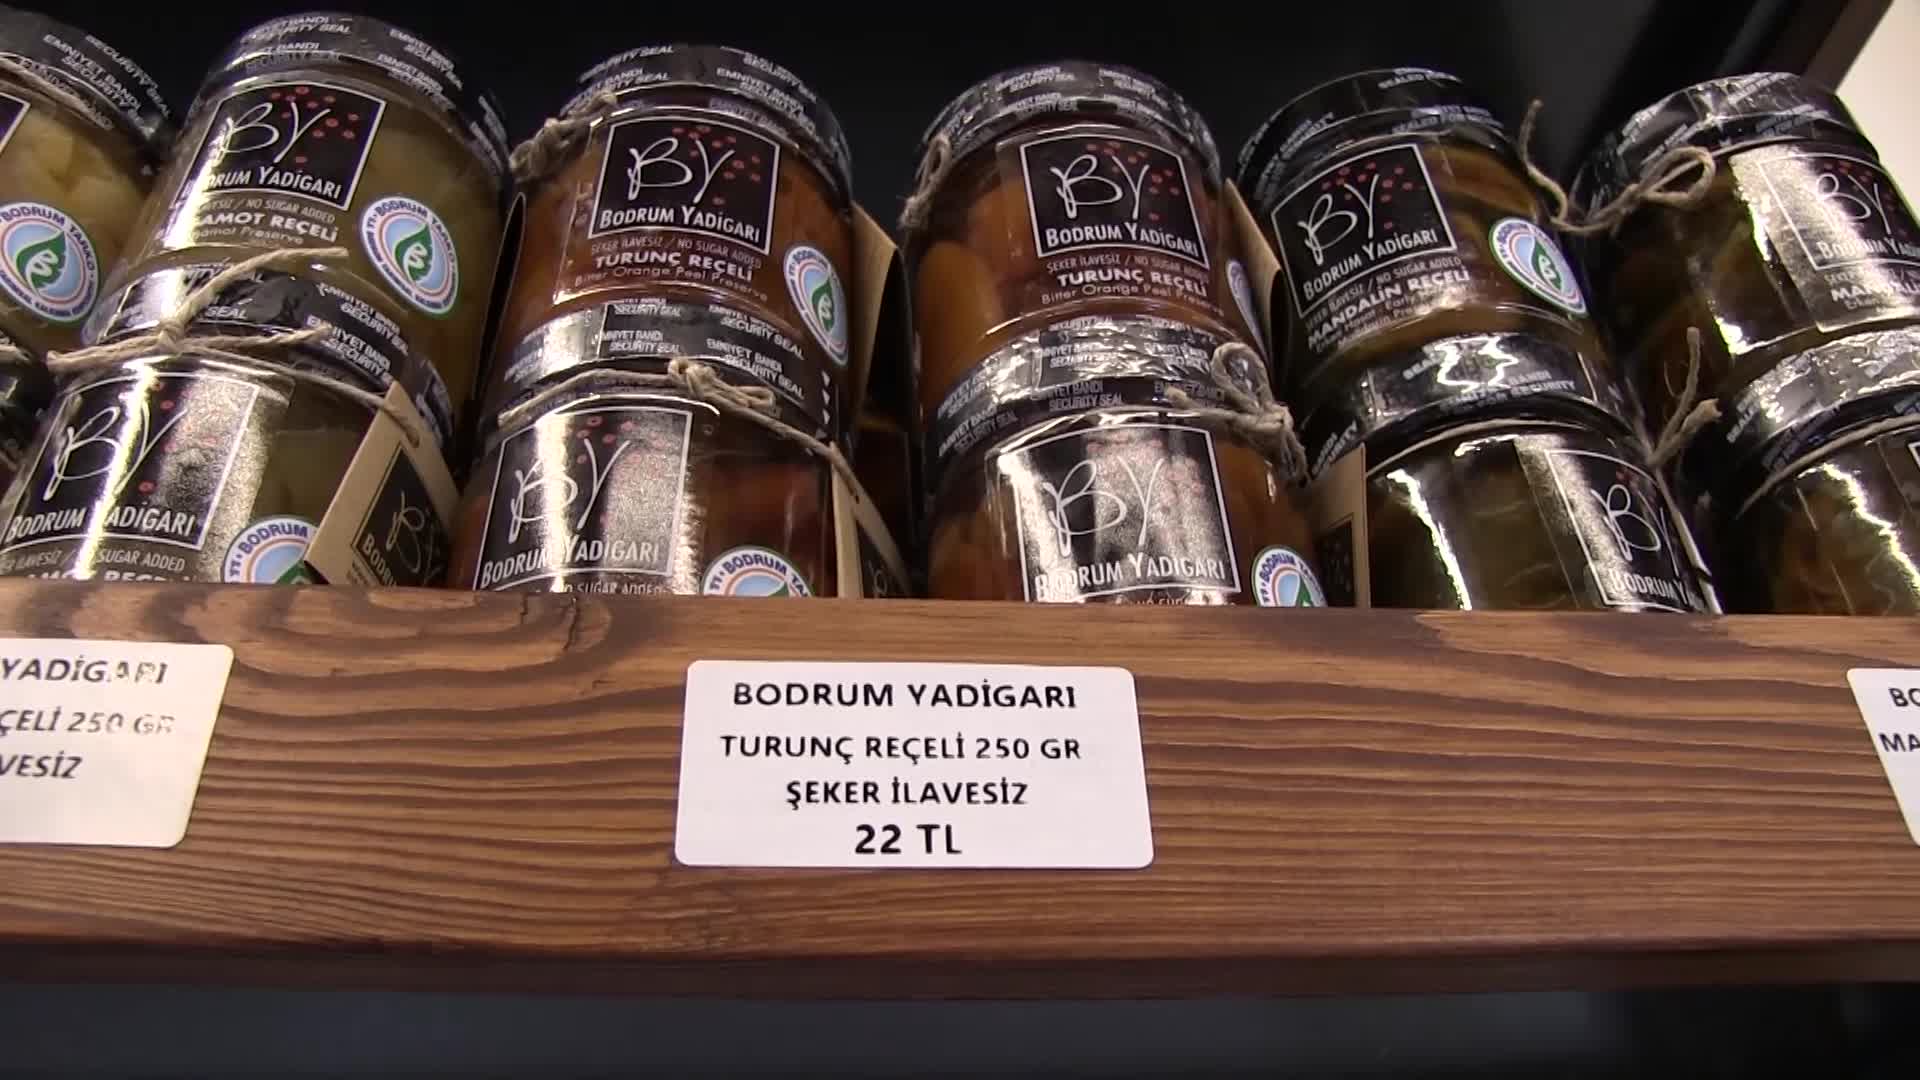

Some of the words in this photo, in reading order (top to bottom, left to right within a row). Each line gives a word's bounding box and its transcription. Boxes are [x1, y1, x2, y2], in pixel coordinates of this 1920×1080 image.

[259, 165, 342, 199] YADİGARI
[0, 206, 67, 227] BODRUM
[263, 200, 300, 213] SUGAR
[373, 200, 429, 218] BODRUM
[270, 213, 339, 244] REÇELİ
[600, 206, 676, 230] BODRUM
[680, 204, 762, 244] YADİGARI
[1045, 224, 1123, 249] BODRUM
[1123, 222, 1201, 258] YADİGARI
[594, 251, 682, 269] TURUNÇ
[688, 251, 753, 283] REÇELİ
[613, 265, 671, 280] Orange
[675, 266, 708, 280] Peel
[1302, 253, 1364, 301] BODRUM
[1361, 228, 1439, 262] YADİGARI
[1056, 269, 1145, 288] TURUNÇ
[1149, 270, 1209, 298] REÇELİ
[1080, 282, 1139, 297] Orange
[205, 305, 249, 319] SEAL
[1307, 283, 1404, 350] MANDALİN
[1510, 380, 1578, 398] SECURITY
[4, 506, 88, 545] BODRUM
[102, 501, 197, 538] ADİGARI
[238, 523, 309, 554] BODRUM
[97, 549, 140, 564] SUGAR
[140, 552, 187, 572] ADDED
[722, 553, 788, 576] BODRUM
[733, 681, 894, 708] BODRUM
[907, 677, 1077, 709] YADİGARI
[66, 711, 124, 735] 250
[720, 734, 855, 766] TURUNÇ
[865, 731, 966, 766] REÇELİ
[974, 737, 1031, 760] 250
[1039, 738, 1082, 760] GR
[785, 780, 881, 811] ŞEKER
[891, 775, 1029, 805] İLAVESİZ
[854, 823, 903, 855] 22
[916, 823, 963, 855] TL
